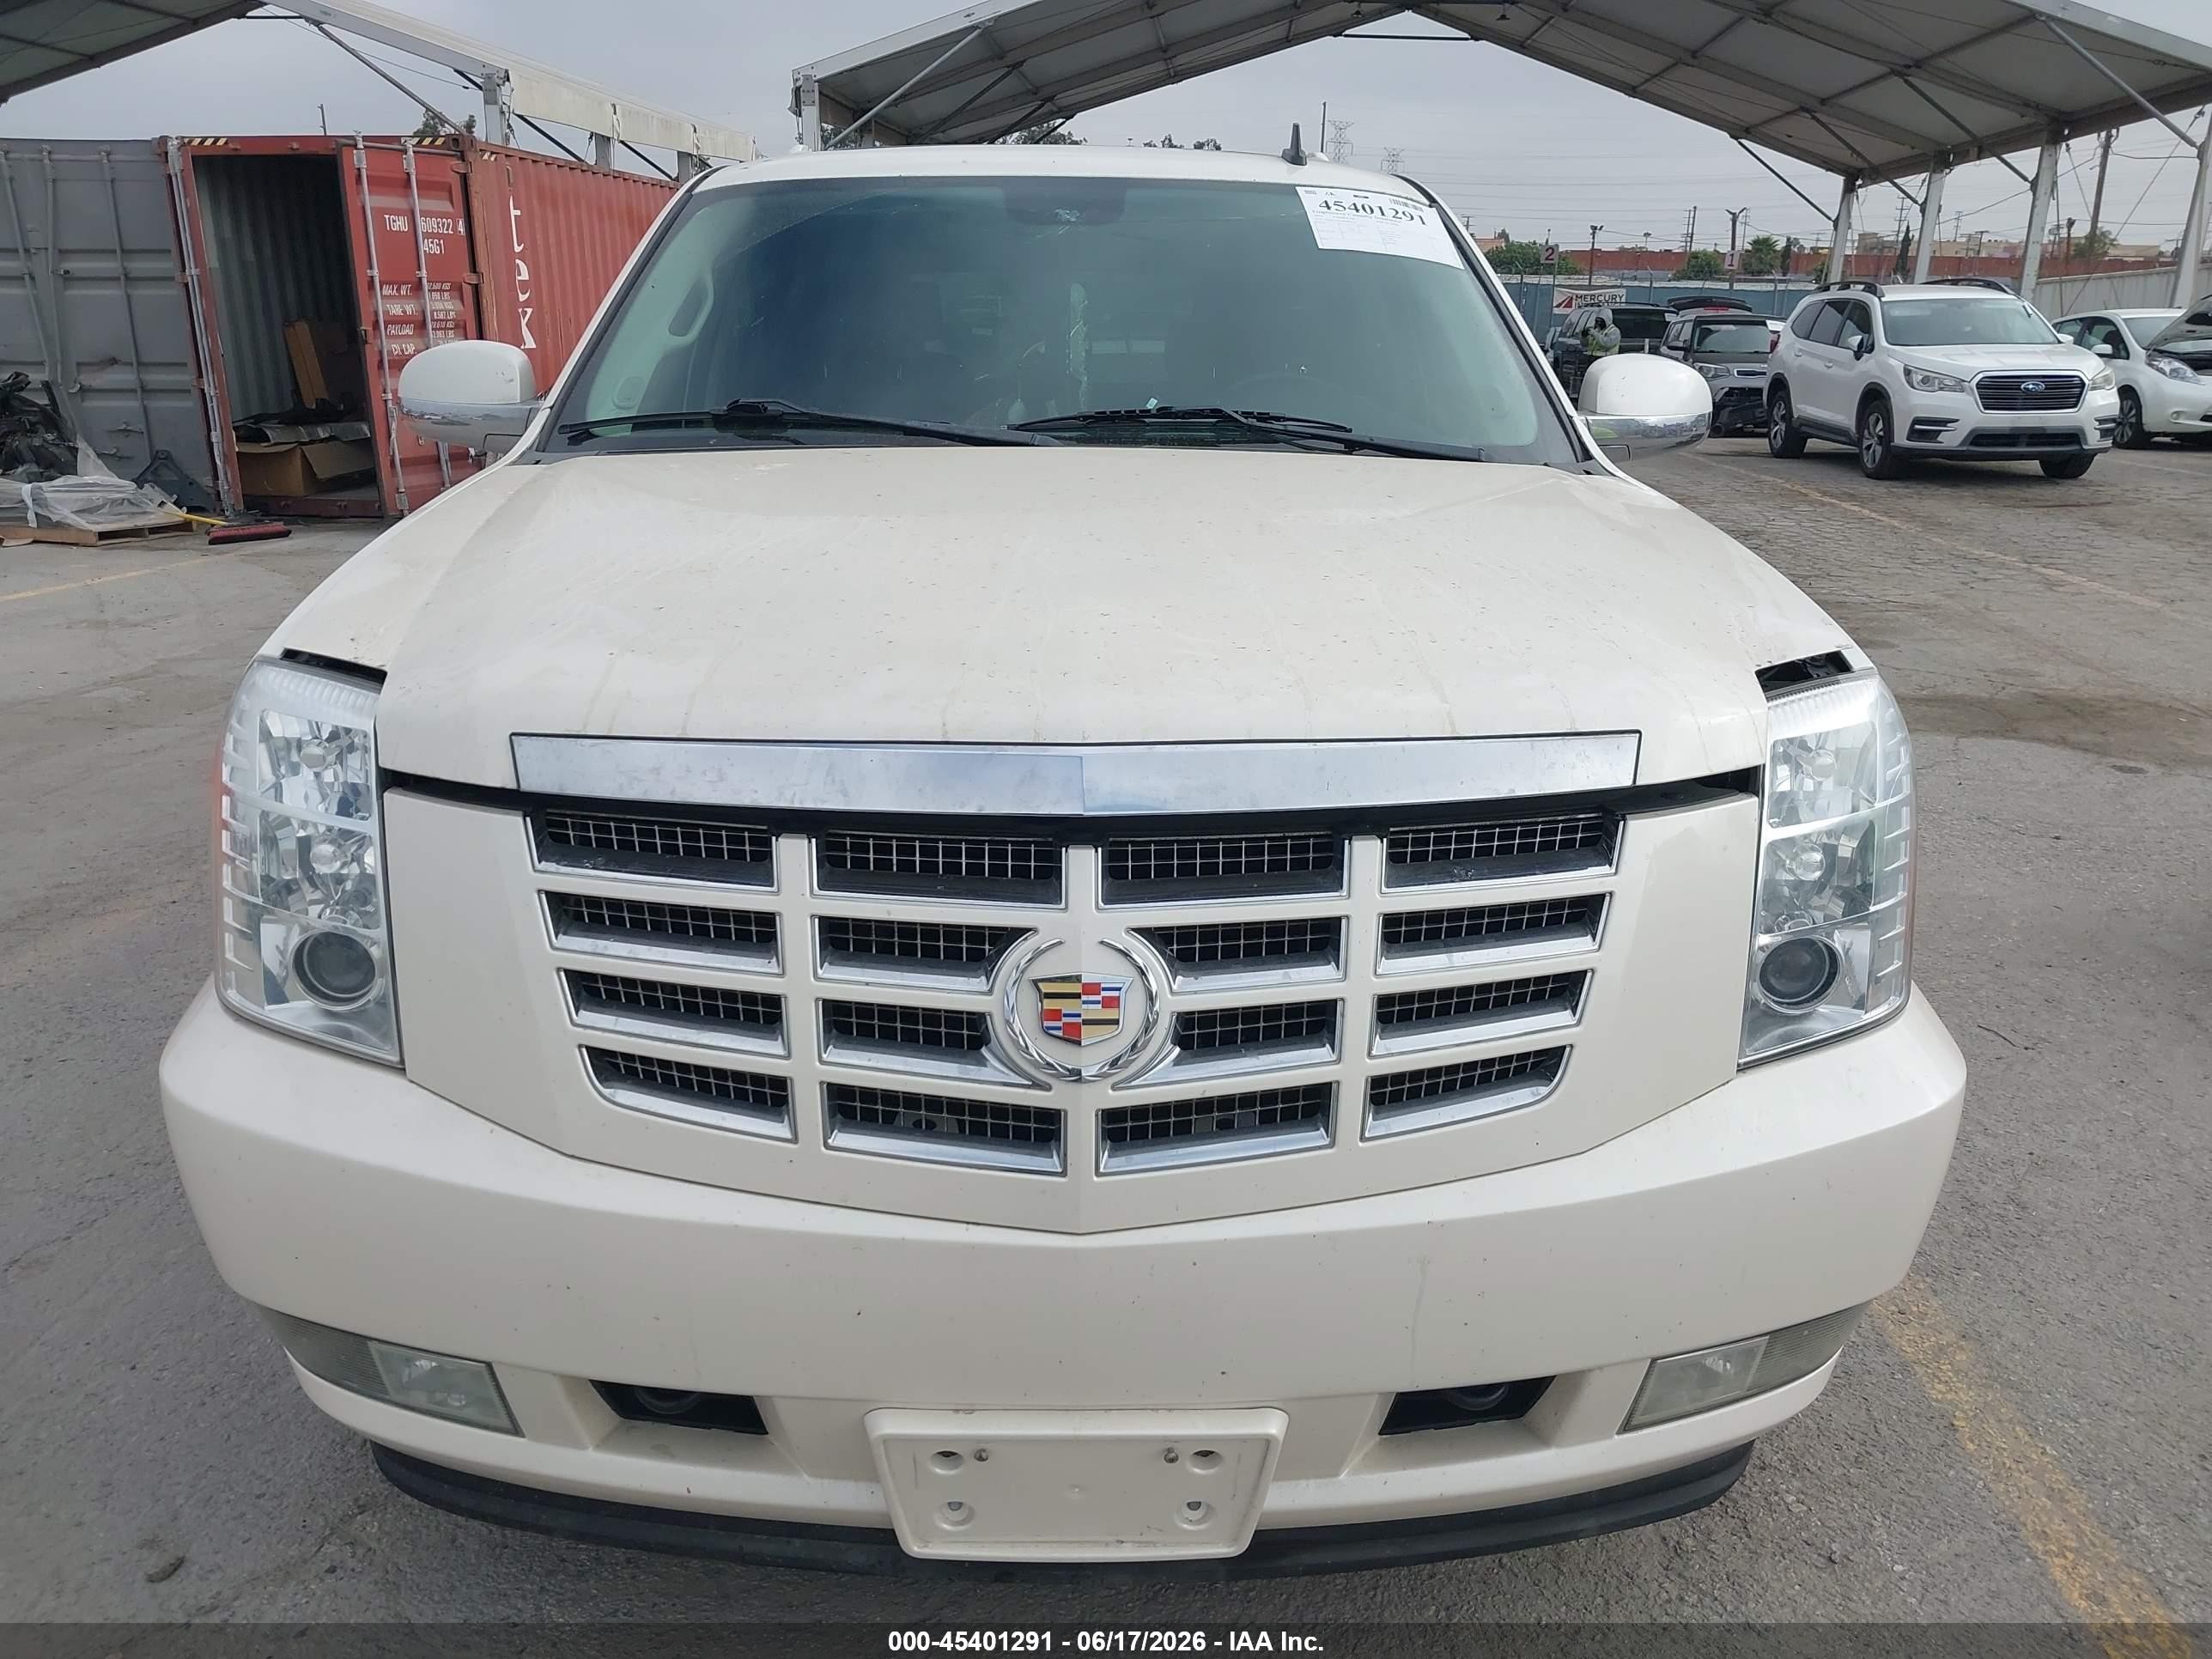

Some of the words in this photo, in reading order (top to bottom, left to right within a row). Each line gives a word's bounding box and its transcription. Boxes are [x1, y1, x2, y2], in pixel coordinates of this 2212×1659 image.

[1319, 199, 1428, 227] 45401291
[384, 215, 409, 232] TGHU
[420, 217, 453, 234] 609322
[423, 238, 445, 254] 45G1
[1545, 246, 1555, 261] 2
[1728, 252, 1735, 267] 1
[382, 284, 398, 296] MAX.
[400, 284, 413, 296] WT.
[1575, 294, 1625, 302] MERCURY
[405, 304, 418, 315] WT.
[386, 324, 414, 336] PAYLOAD
